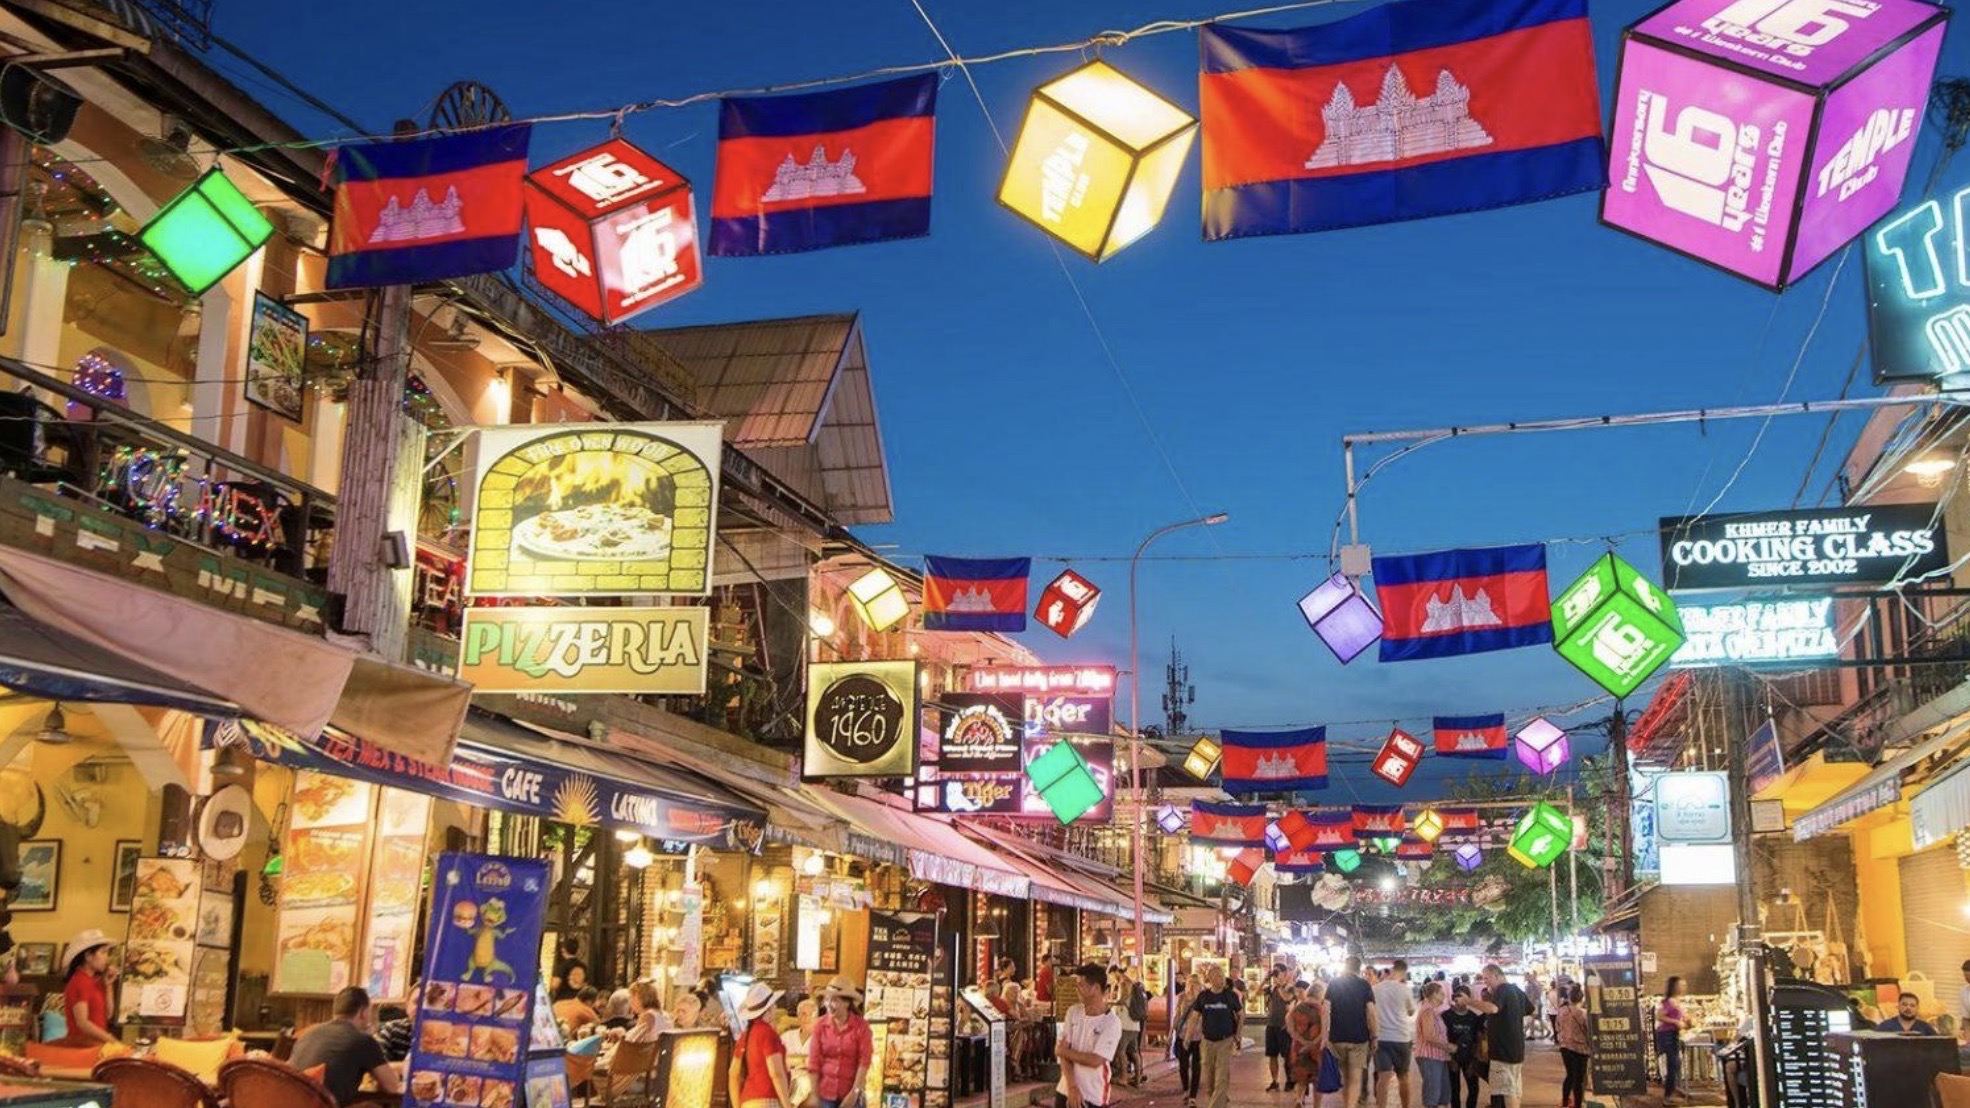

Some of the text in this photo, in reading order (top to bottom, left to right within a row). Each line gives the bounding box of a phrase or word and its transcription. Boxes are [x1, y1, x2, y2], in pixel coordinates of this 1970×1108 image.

[1643, 93, 1737, 226] 16
[1817, 108, 1915, 199] TEMPLE
[1721, 122, 1761, 232] years
[1724, 514, 1871, 539] KHMER FAMILY
[1672, 530, 1935, 565] COOKING CLASS
[1747, 558, 1858, 578] SINCE 2002
[1747, 597, 1833, 630] FAMILY
[464, 619, 699, 678] PIZZERIA
[1777, 626, 1839, 656] PIZZA
[831, 711, 887, 747] 1960
[502, 768, 543, 804] CAFE
[611, 792, 658, 827] LATINO
